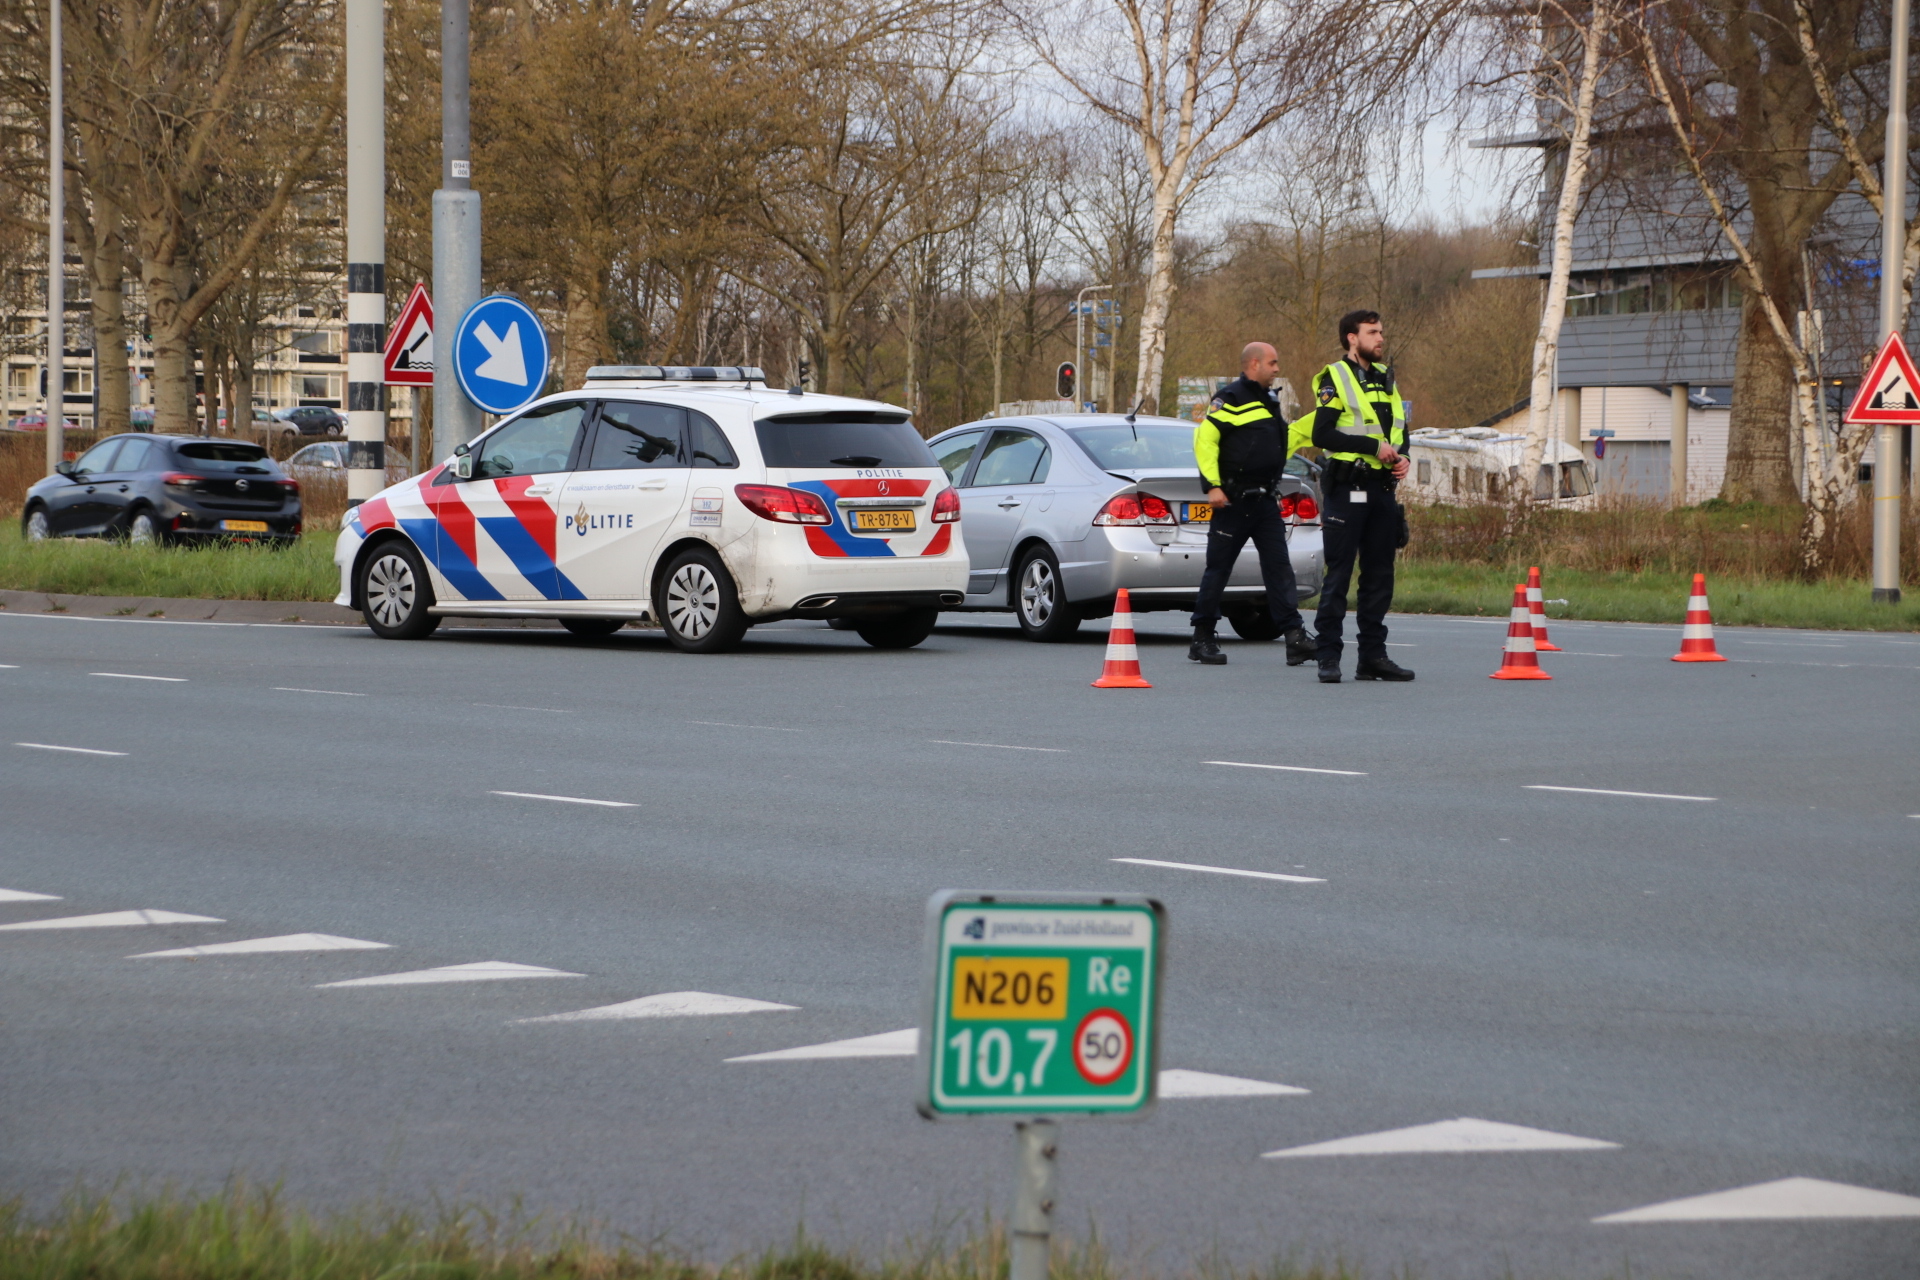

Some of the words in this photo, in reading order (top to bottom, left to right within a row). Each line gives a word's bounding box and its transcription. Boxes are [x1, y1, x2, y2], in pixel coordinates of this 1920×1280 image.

[856, 469, 904, 478] POLITIE
[565, 514, 634, 537] POLITIE
[859, 513, 910, 528] TR-878-V
[991, 919, 1050, 938] provincie
[1053, 918, 1135, 936] Zuid-Holland
[1087, 956, 1132, 996] Re
[963, 971, 1056, 1007] N206
[1084, 1032, 1122, 1060] 50
[948, 1027, 1059, 1095] 10,7
